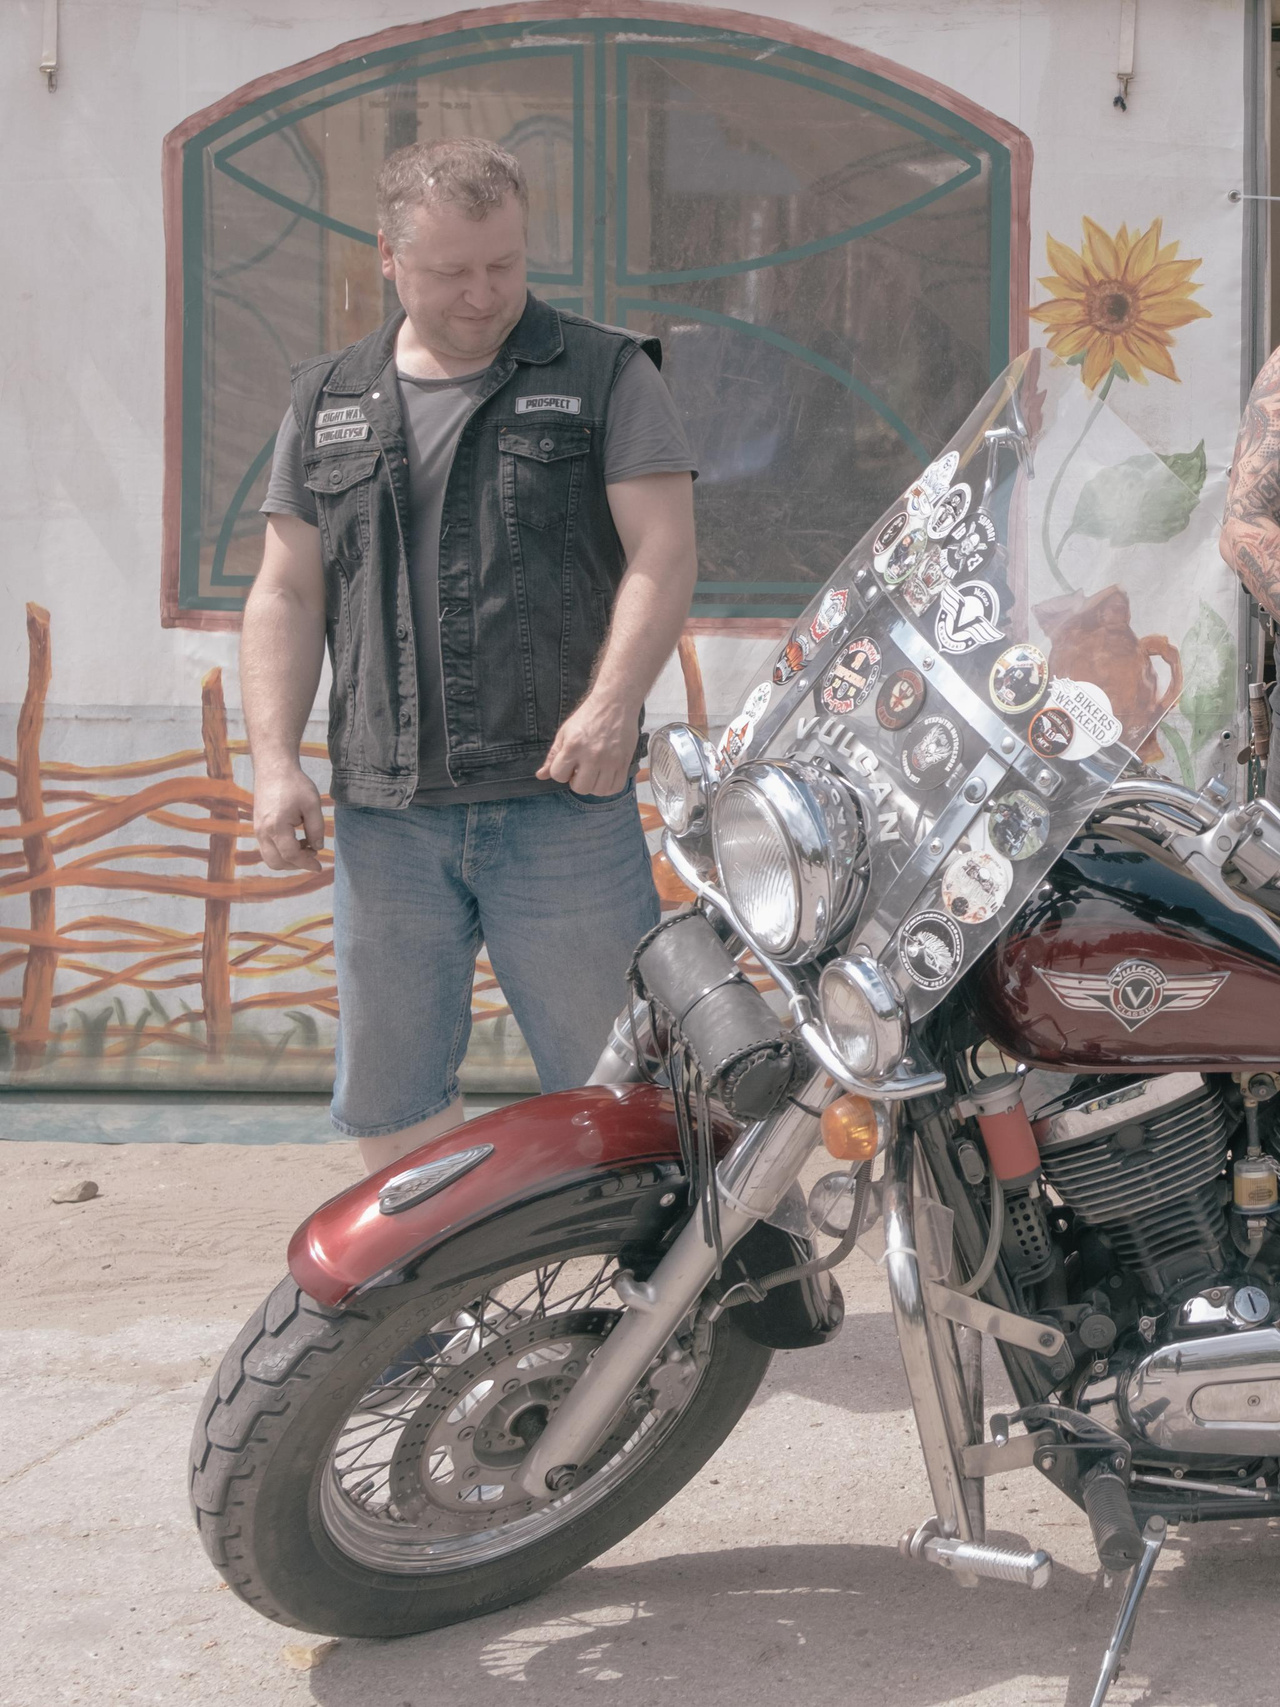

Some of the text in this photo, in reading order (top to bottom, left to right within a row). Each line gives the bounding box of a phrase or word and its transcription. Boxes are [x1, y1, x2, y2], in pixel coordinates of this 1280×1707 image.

[525, 397, 571, 410] PROSPECT
[322, 410, 345, 424] RIGHT
[978, 514, 996, 542] SUPPORT
[973, 587, 990, 607] Vulcan
[1055, 690, 1106, 742] WEEKEND
[1073, 691, 1115, 732] BIKERS
[796, 714, 903, 842] VULCAN
[1111, 964, 1164, 984] Vulcan
[1124, 986, 1152, 1009] V
[1116, 1003, 1155, 1018] CLASSIC
